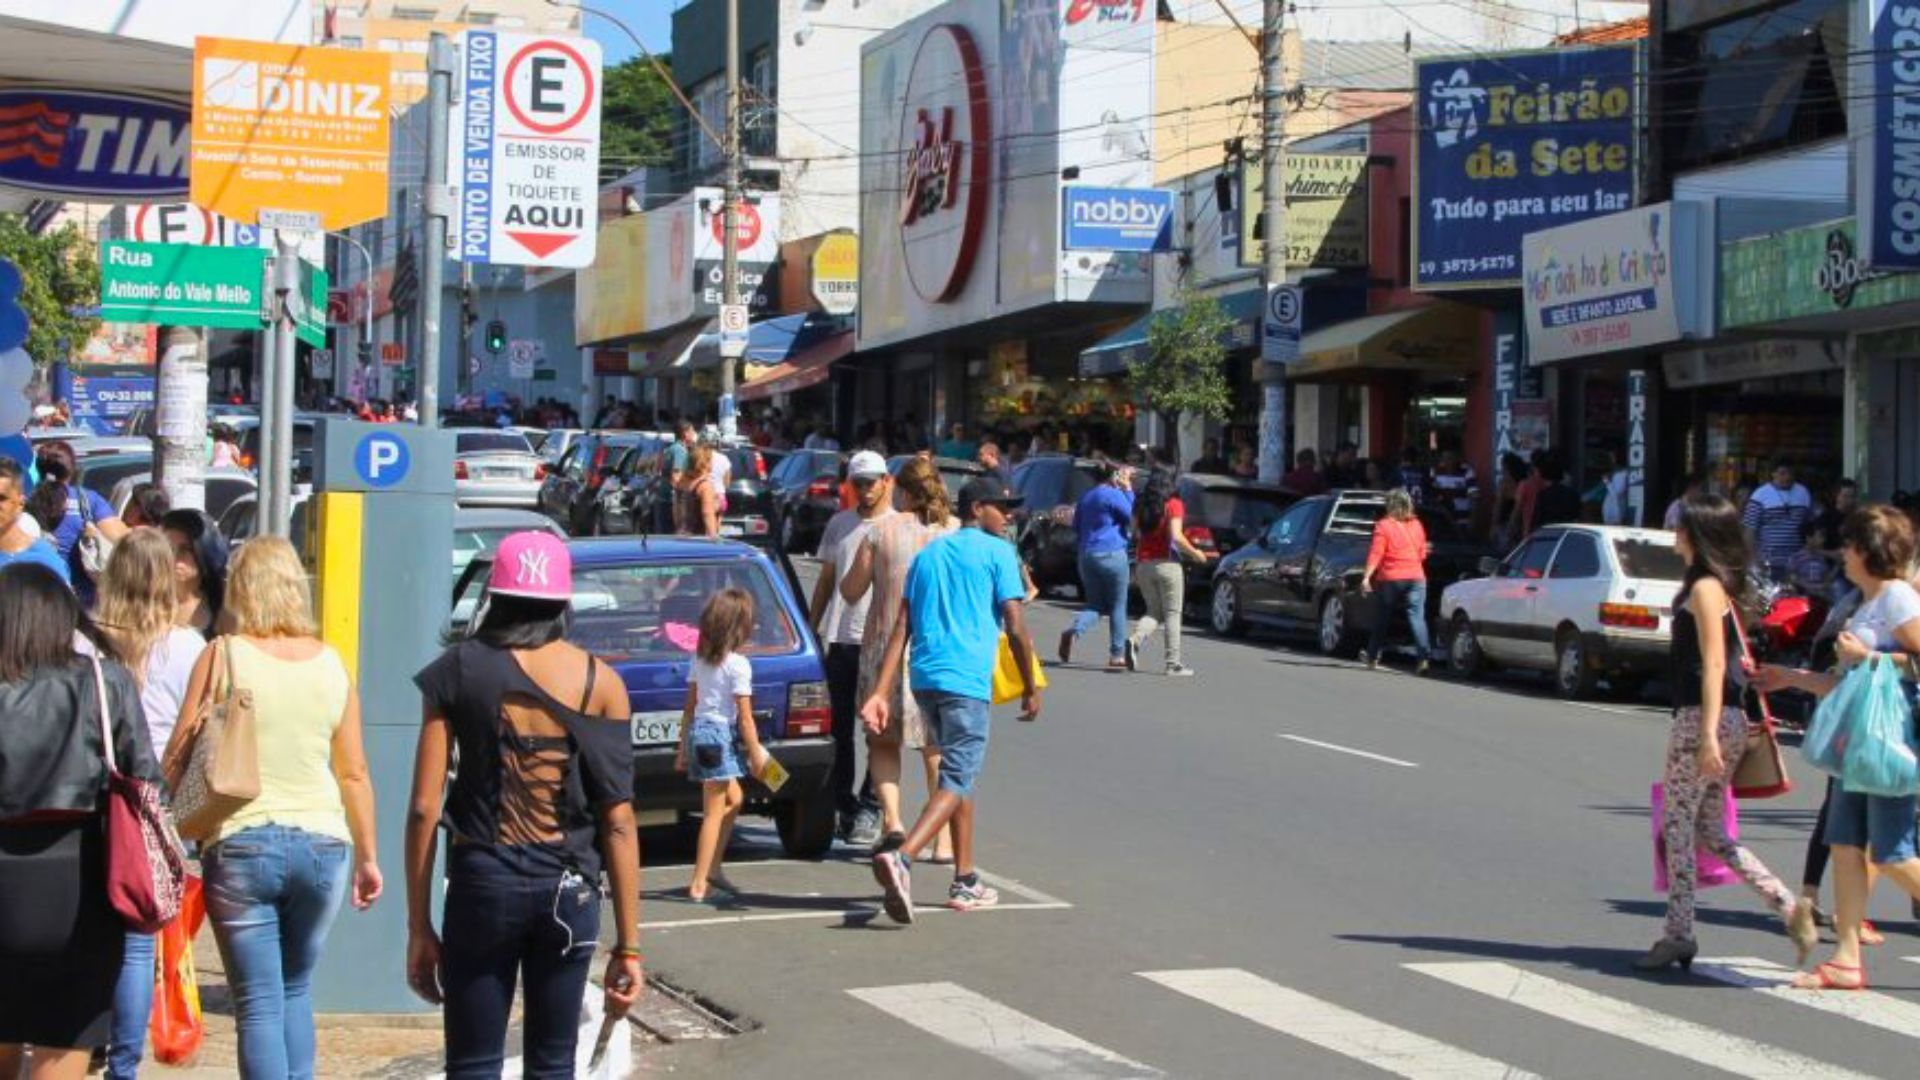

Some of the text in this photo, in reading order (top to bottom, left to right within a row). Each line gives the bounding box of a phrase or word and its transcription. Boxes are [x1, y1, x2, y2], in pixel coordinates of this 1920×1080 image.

[263, 77, 382, 119] DINIZ
[531, 57, 566, 113] E
[1488, 79, 1629, 126] Feirão
[76, 114, 192, 179] TIM
[465, 35, 493, 257] PONTO DE VENDA FIXO
[505, 142, 587, 162] EMISSOR
[1465, 138, 1628, 179] da Sete
[534, 164, 556, 179] DE
[1284, 158, 1366, 172] OJOARIA
[507, 183, 583, 201] TIQUETE
[1431, 188, 1629, 222] Tudo para seu lar
[504, 204, 584, 229] AQUI
[1073, 196, 1166, 230] nobby
[109, 246, 153, 267] Rua
[709, 264, 764, 286] Óica
[109, 279, 252, 305] Antonio do Vale Mello
[704, 287, 767, 305] Esdio
[1280, 294, 1290, 316] E
[369, 440, 398, 478] P
